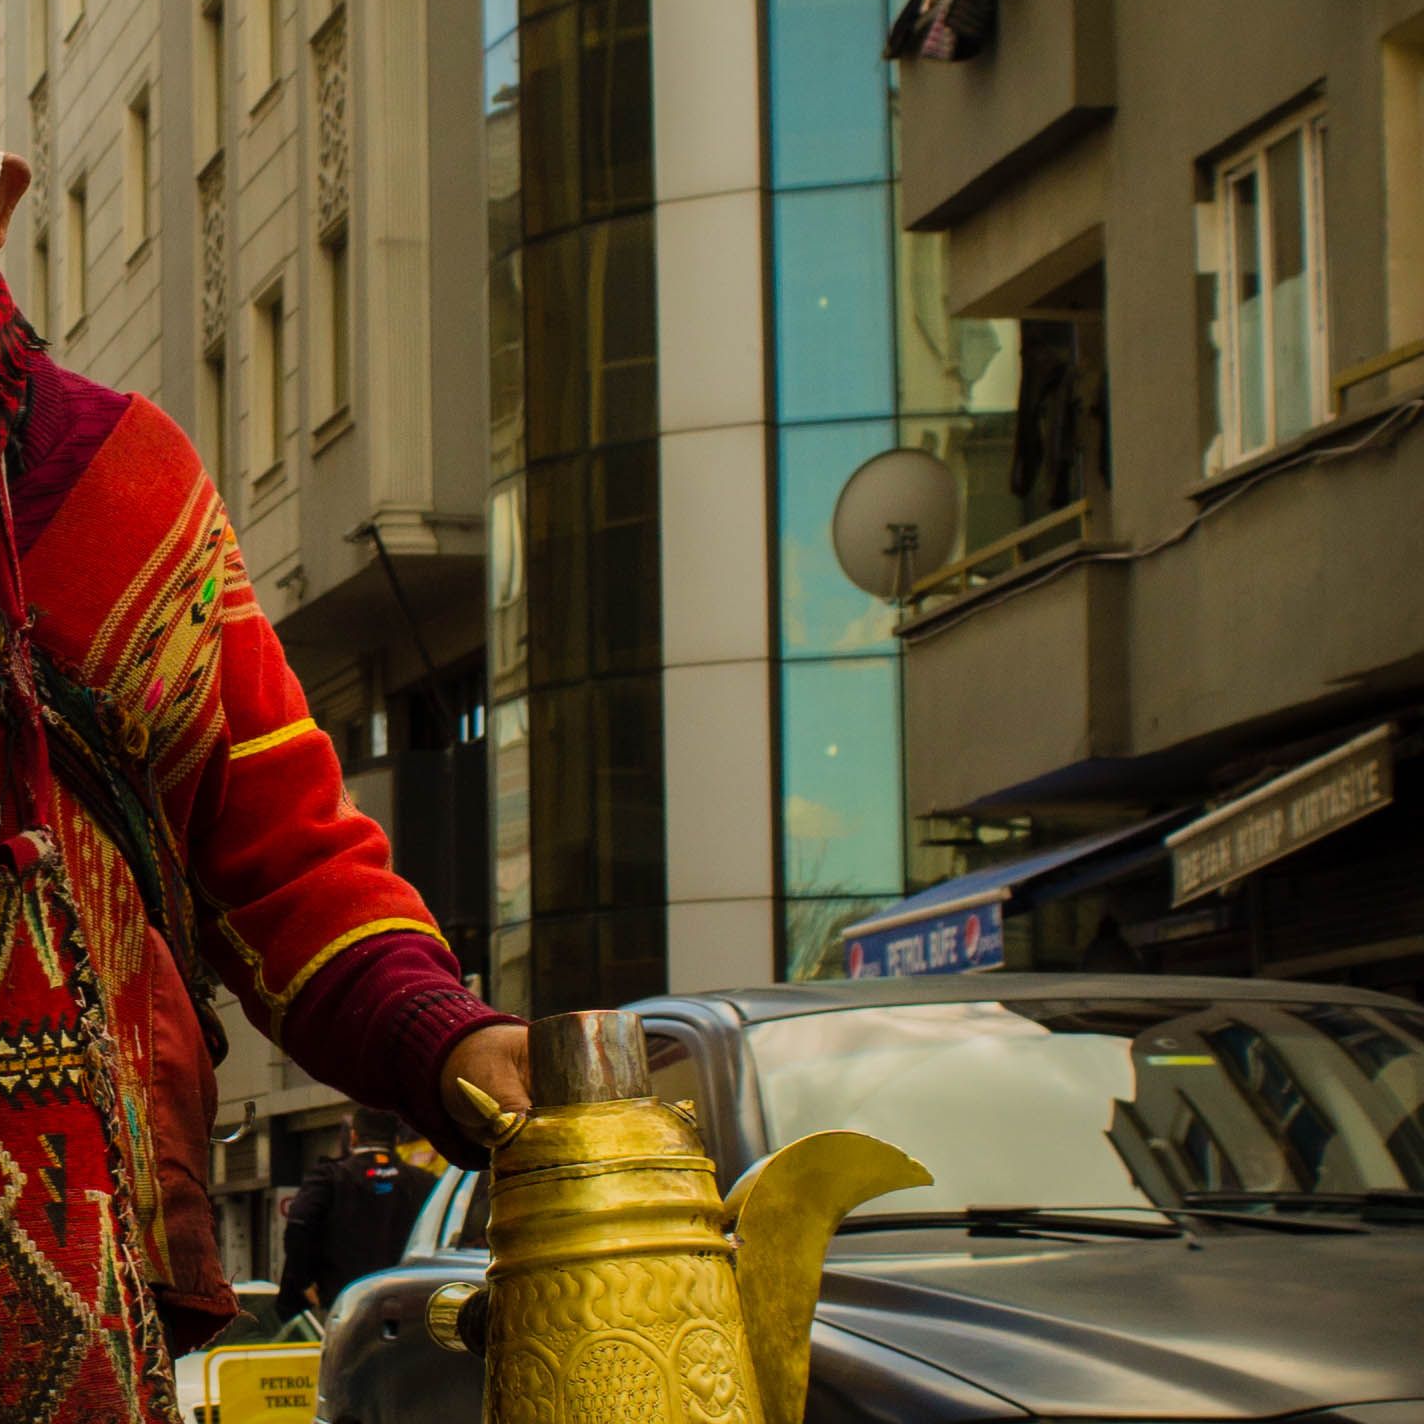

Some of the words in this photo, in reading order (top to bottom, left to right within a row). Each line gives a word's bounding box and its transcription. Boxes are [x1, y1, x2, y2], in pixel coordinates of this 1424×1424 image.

[1290, 759, 1380, 839] KIRTASİYE
[260, 1376, 314, 1390] PETROL
[265, 1394, 310, 1408] TEKEL
